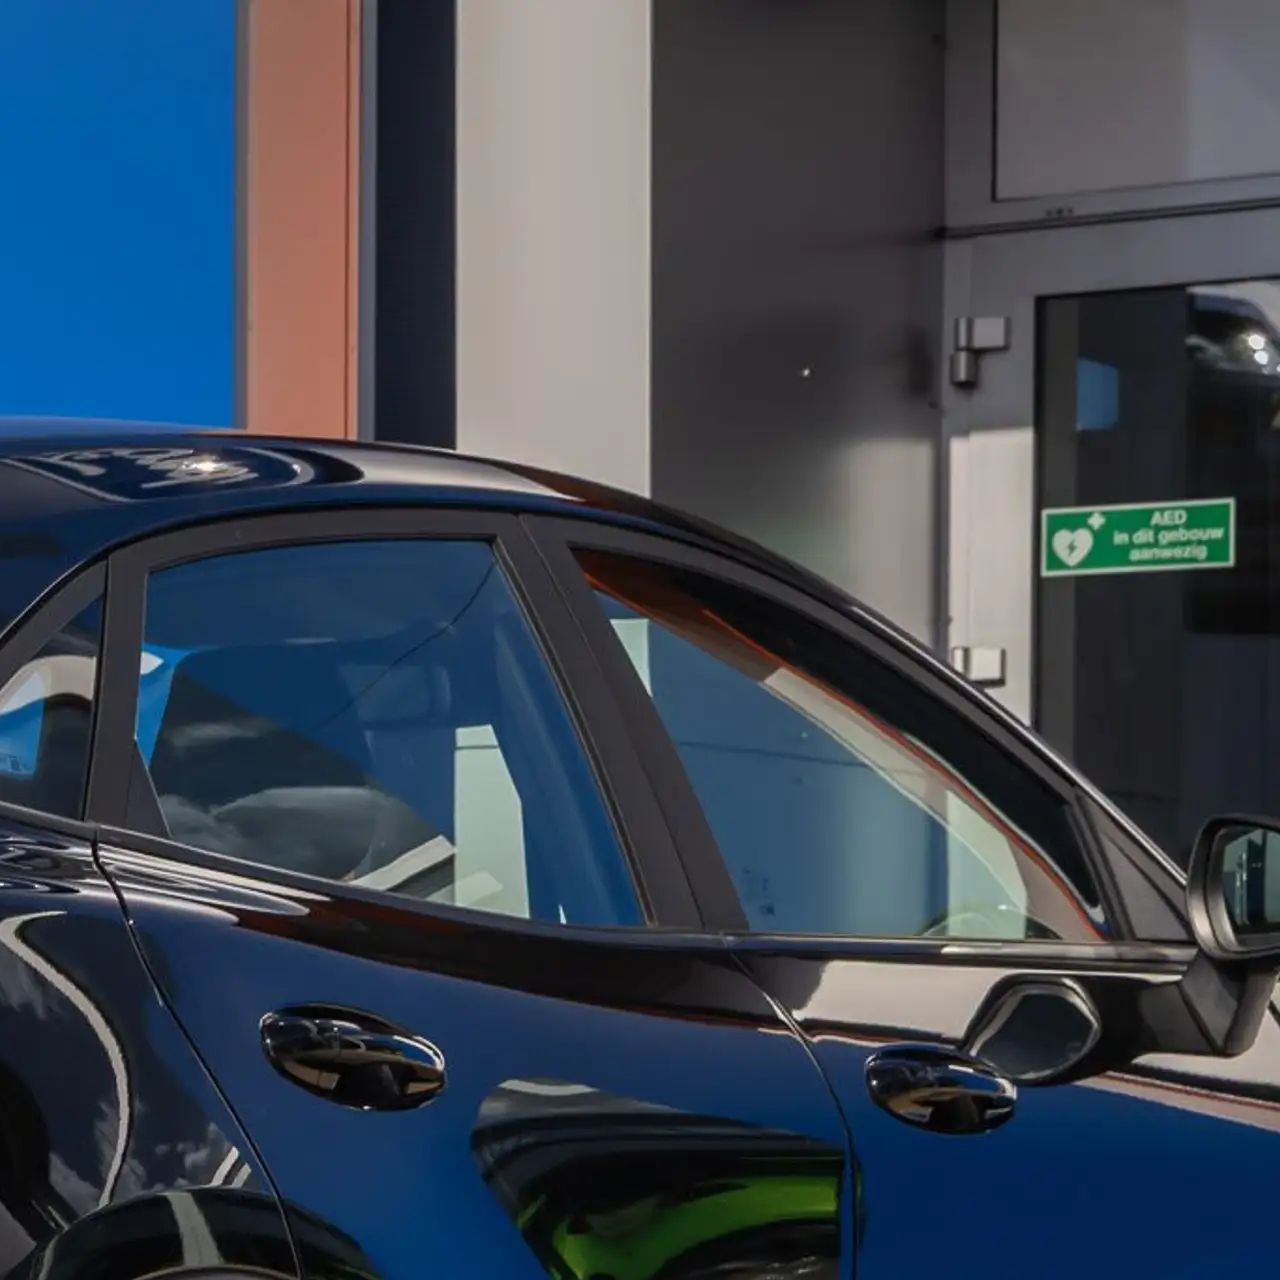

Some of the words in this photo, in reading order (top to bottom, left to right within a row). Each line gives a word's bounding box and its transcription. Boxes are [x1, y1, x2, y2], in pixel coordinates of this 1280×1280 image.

[1150, 510, 1187, 526] AED
[1113, 530, 1129, 545] in
[1132, 528, 1154, 545] dit
[1158, 527, 1224, 545] gebouw
[1129, 546, 1207, 561] aanwezig
